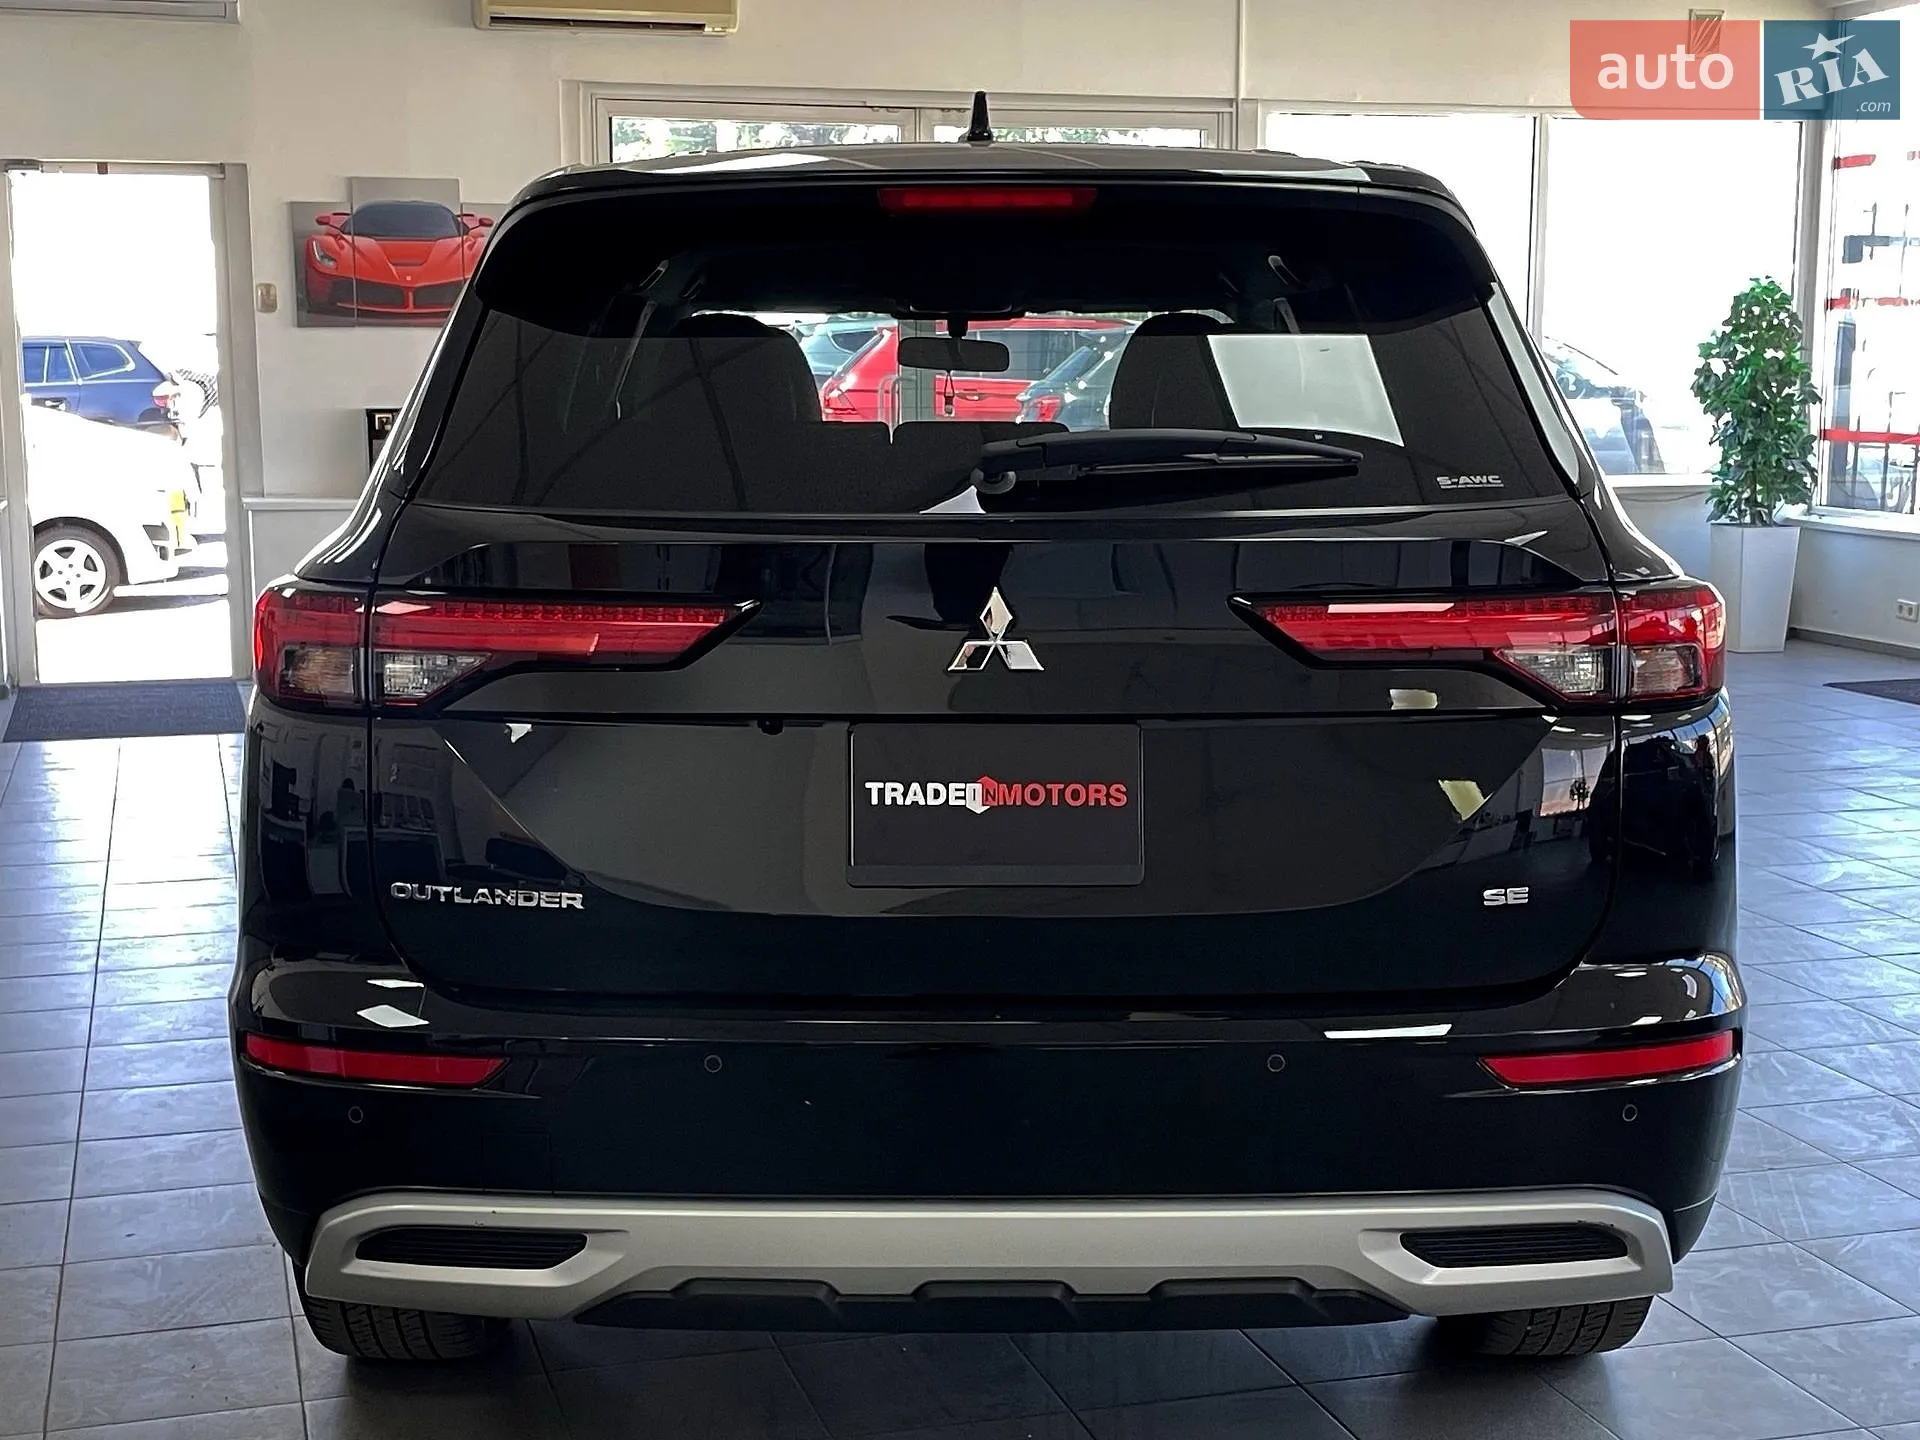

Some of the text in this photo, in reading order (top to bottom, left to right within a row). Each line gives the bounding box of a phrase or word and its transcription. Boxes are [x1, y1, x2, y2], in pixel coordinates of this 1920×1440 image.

[1436, 475, 1502, 485] S-AWC
[390, 881, 584, 909] OUTLANDER
[1483, 887, 1529, 906] SE
